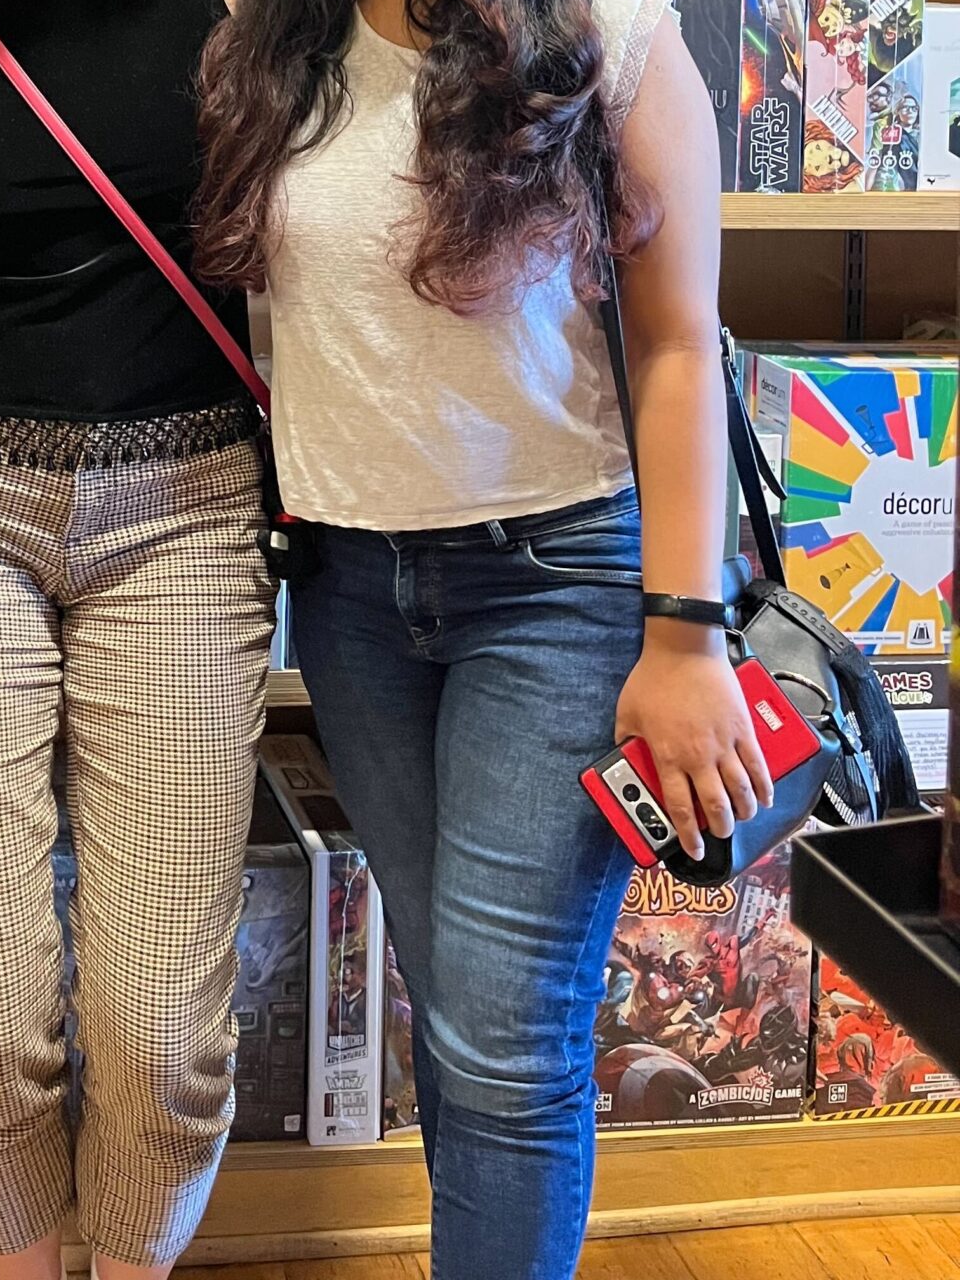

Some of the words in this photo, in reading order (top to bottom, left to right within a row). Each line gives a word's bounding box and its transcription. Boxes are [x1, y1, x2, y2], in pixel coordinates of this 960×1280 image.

[750, 97, 772, 185] STAR
[768, 98, 789, 186] WARS
[883, 492, 953, 515] décoru
[881, 674, 931, 690] AMES
[892, 692, 924, 703] LOVE
[621, 869, 735, 915] OMBIES
[689, 1094, 696, 1103] A
[699, 1086, 771, 1106] ZOMBICIDE
[774, 1088, 801, 1099] GAME
